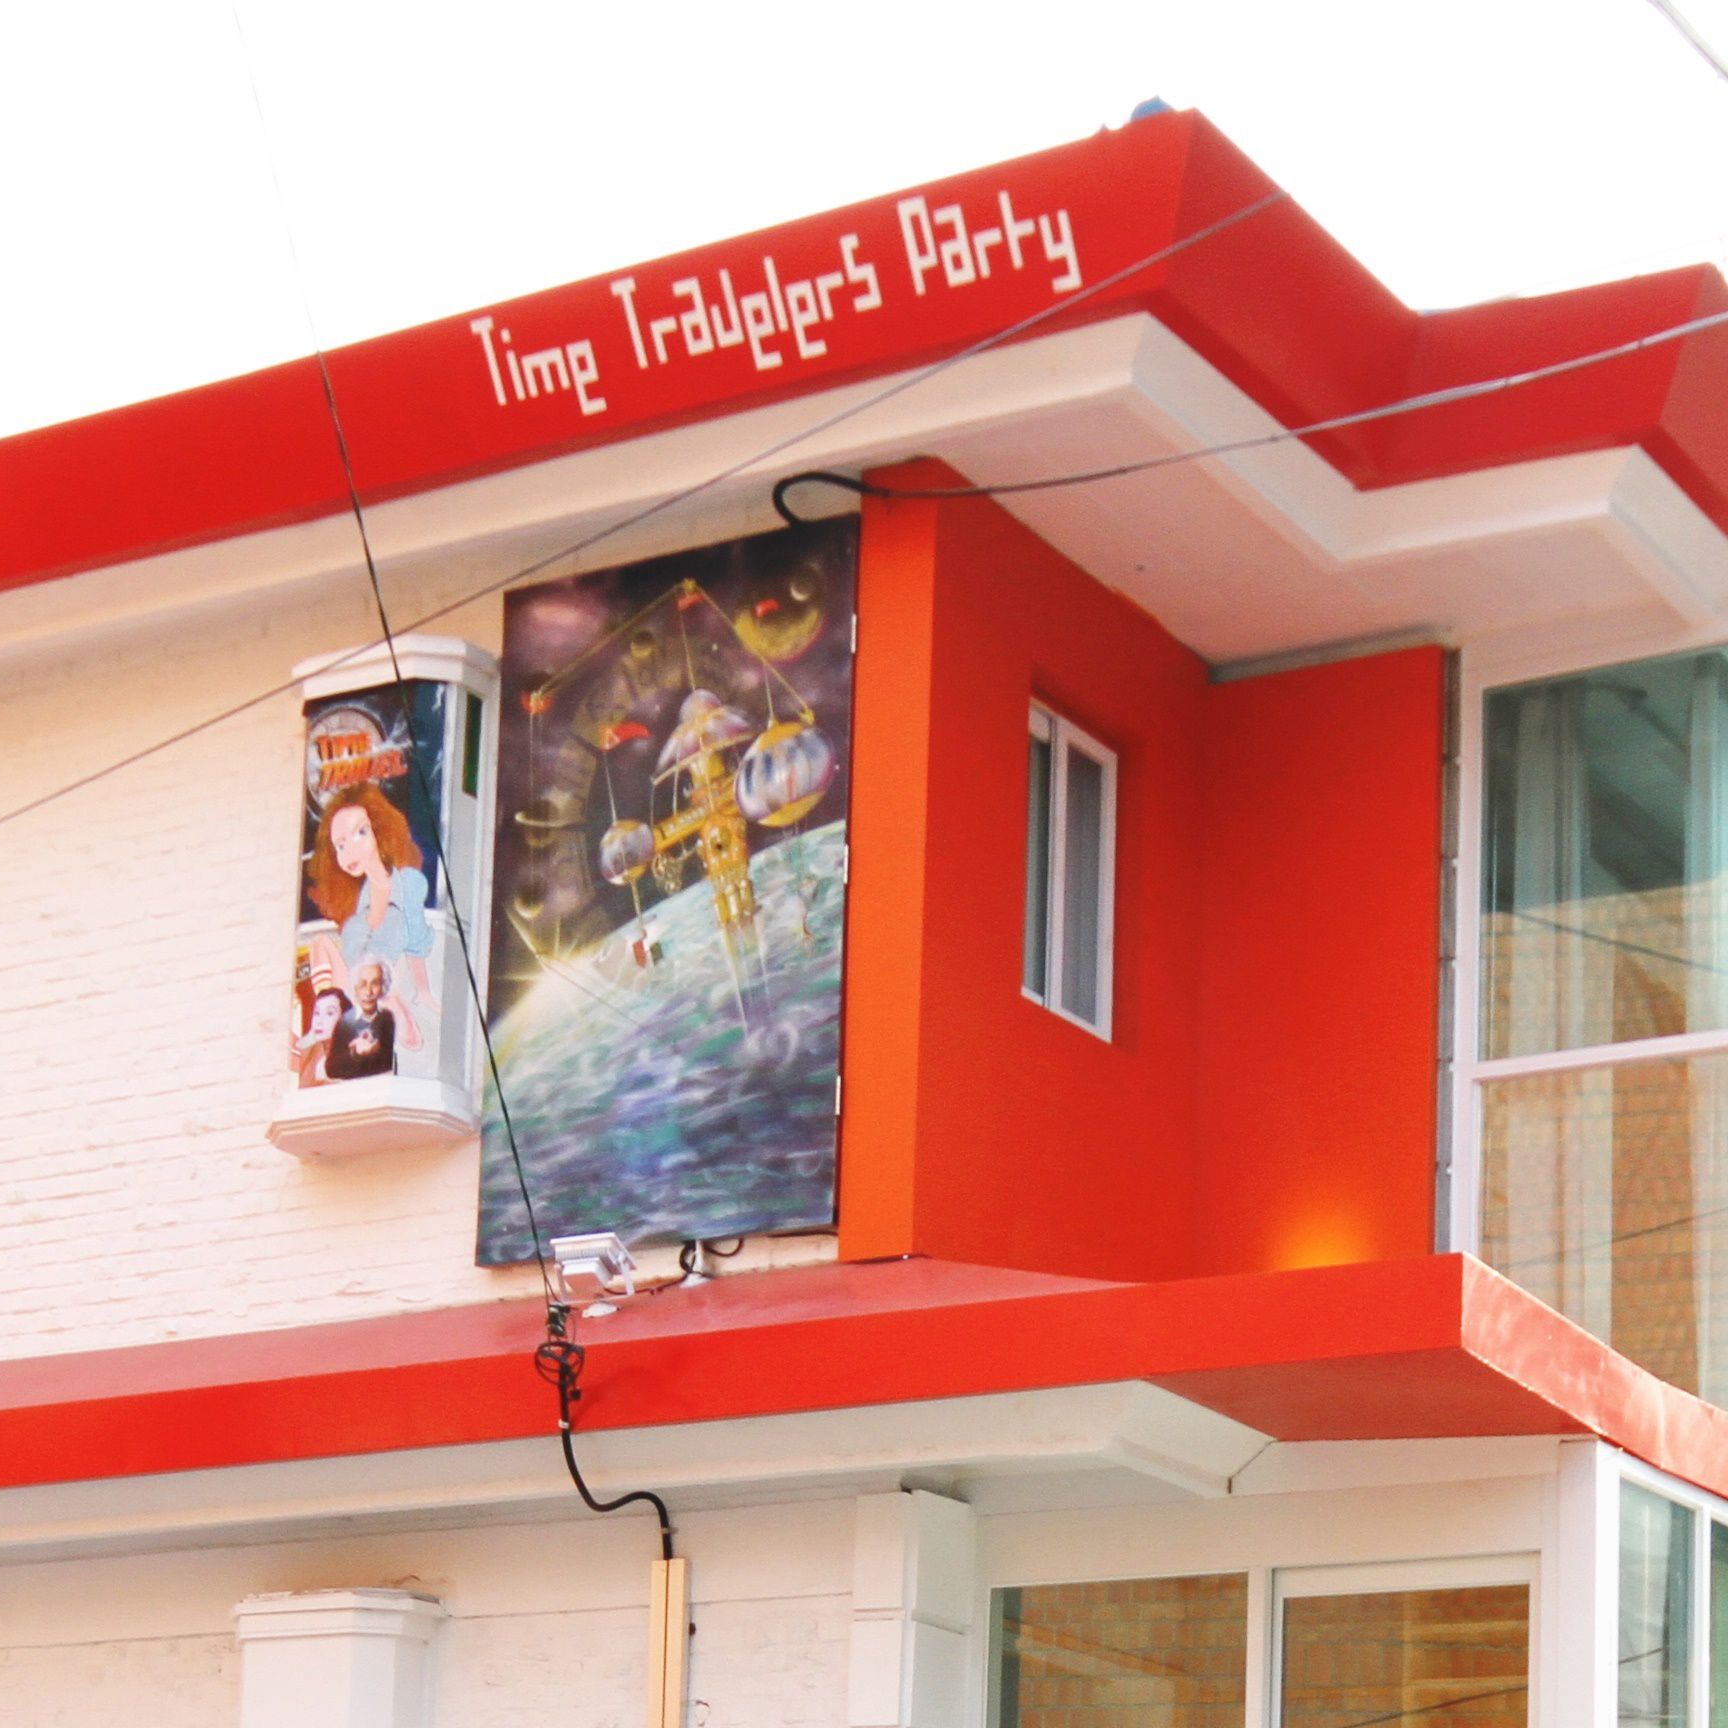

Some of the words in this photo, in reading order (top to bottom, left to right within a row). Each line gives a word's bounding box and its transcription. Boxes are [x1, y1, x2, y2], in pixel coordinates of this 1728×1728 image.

[470, 316, 607, 416] Time
[610, 233, 882, 371] Travelers
[896, 190, 1081, 295] Party
